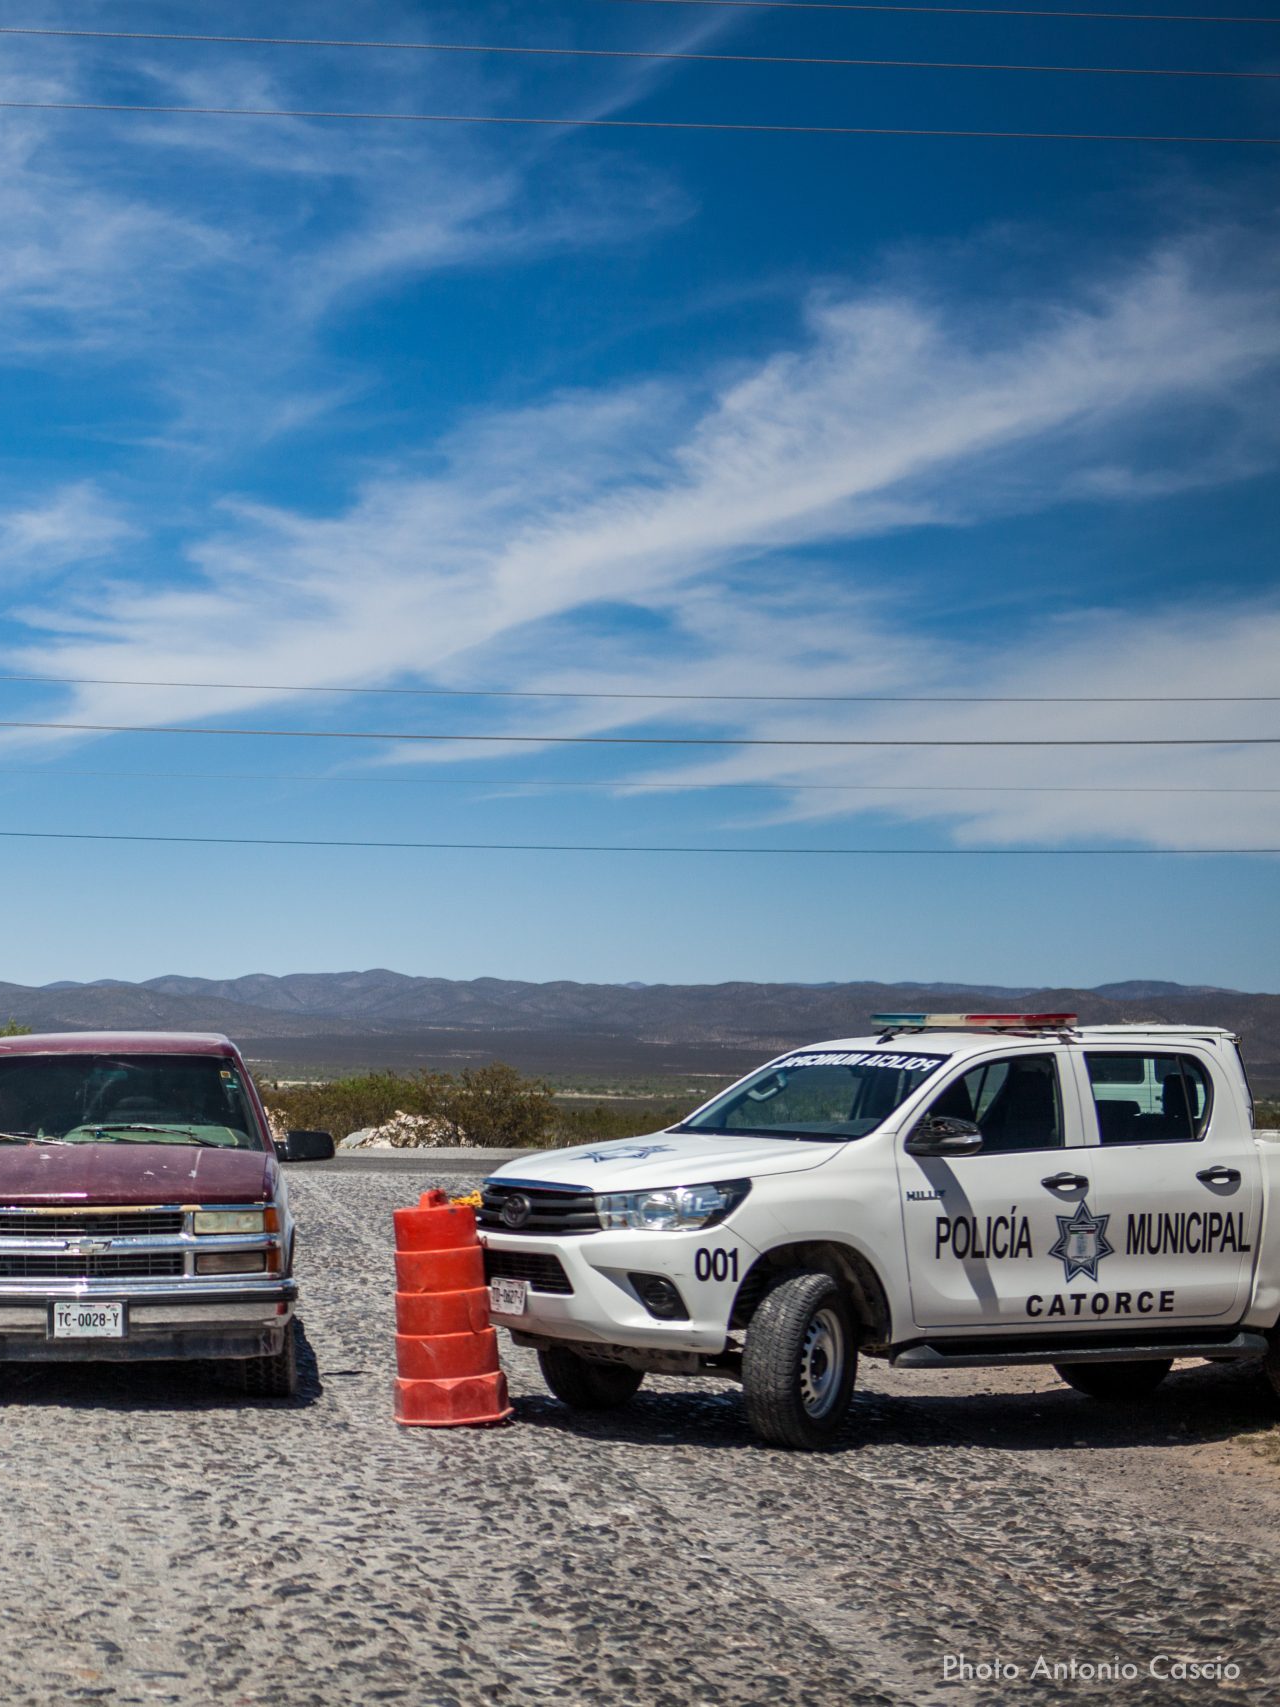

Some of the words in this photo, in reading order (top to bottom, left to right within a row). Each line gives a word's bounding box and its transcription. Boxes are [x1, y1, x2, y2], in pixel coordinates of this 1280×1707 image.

[936, 1206, 1033, 1259] POLICÍA
[1126, 1211, 1251, 1255] MUNICIPAL
[695, 1247, 738, 1283] 001
[57, 1312, 119, 1327] TC-0028-Y
[1026, 1291, 1175, 1317] CATORCE
